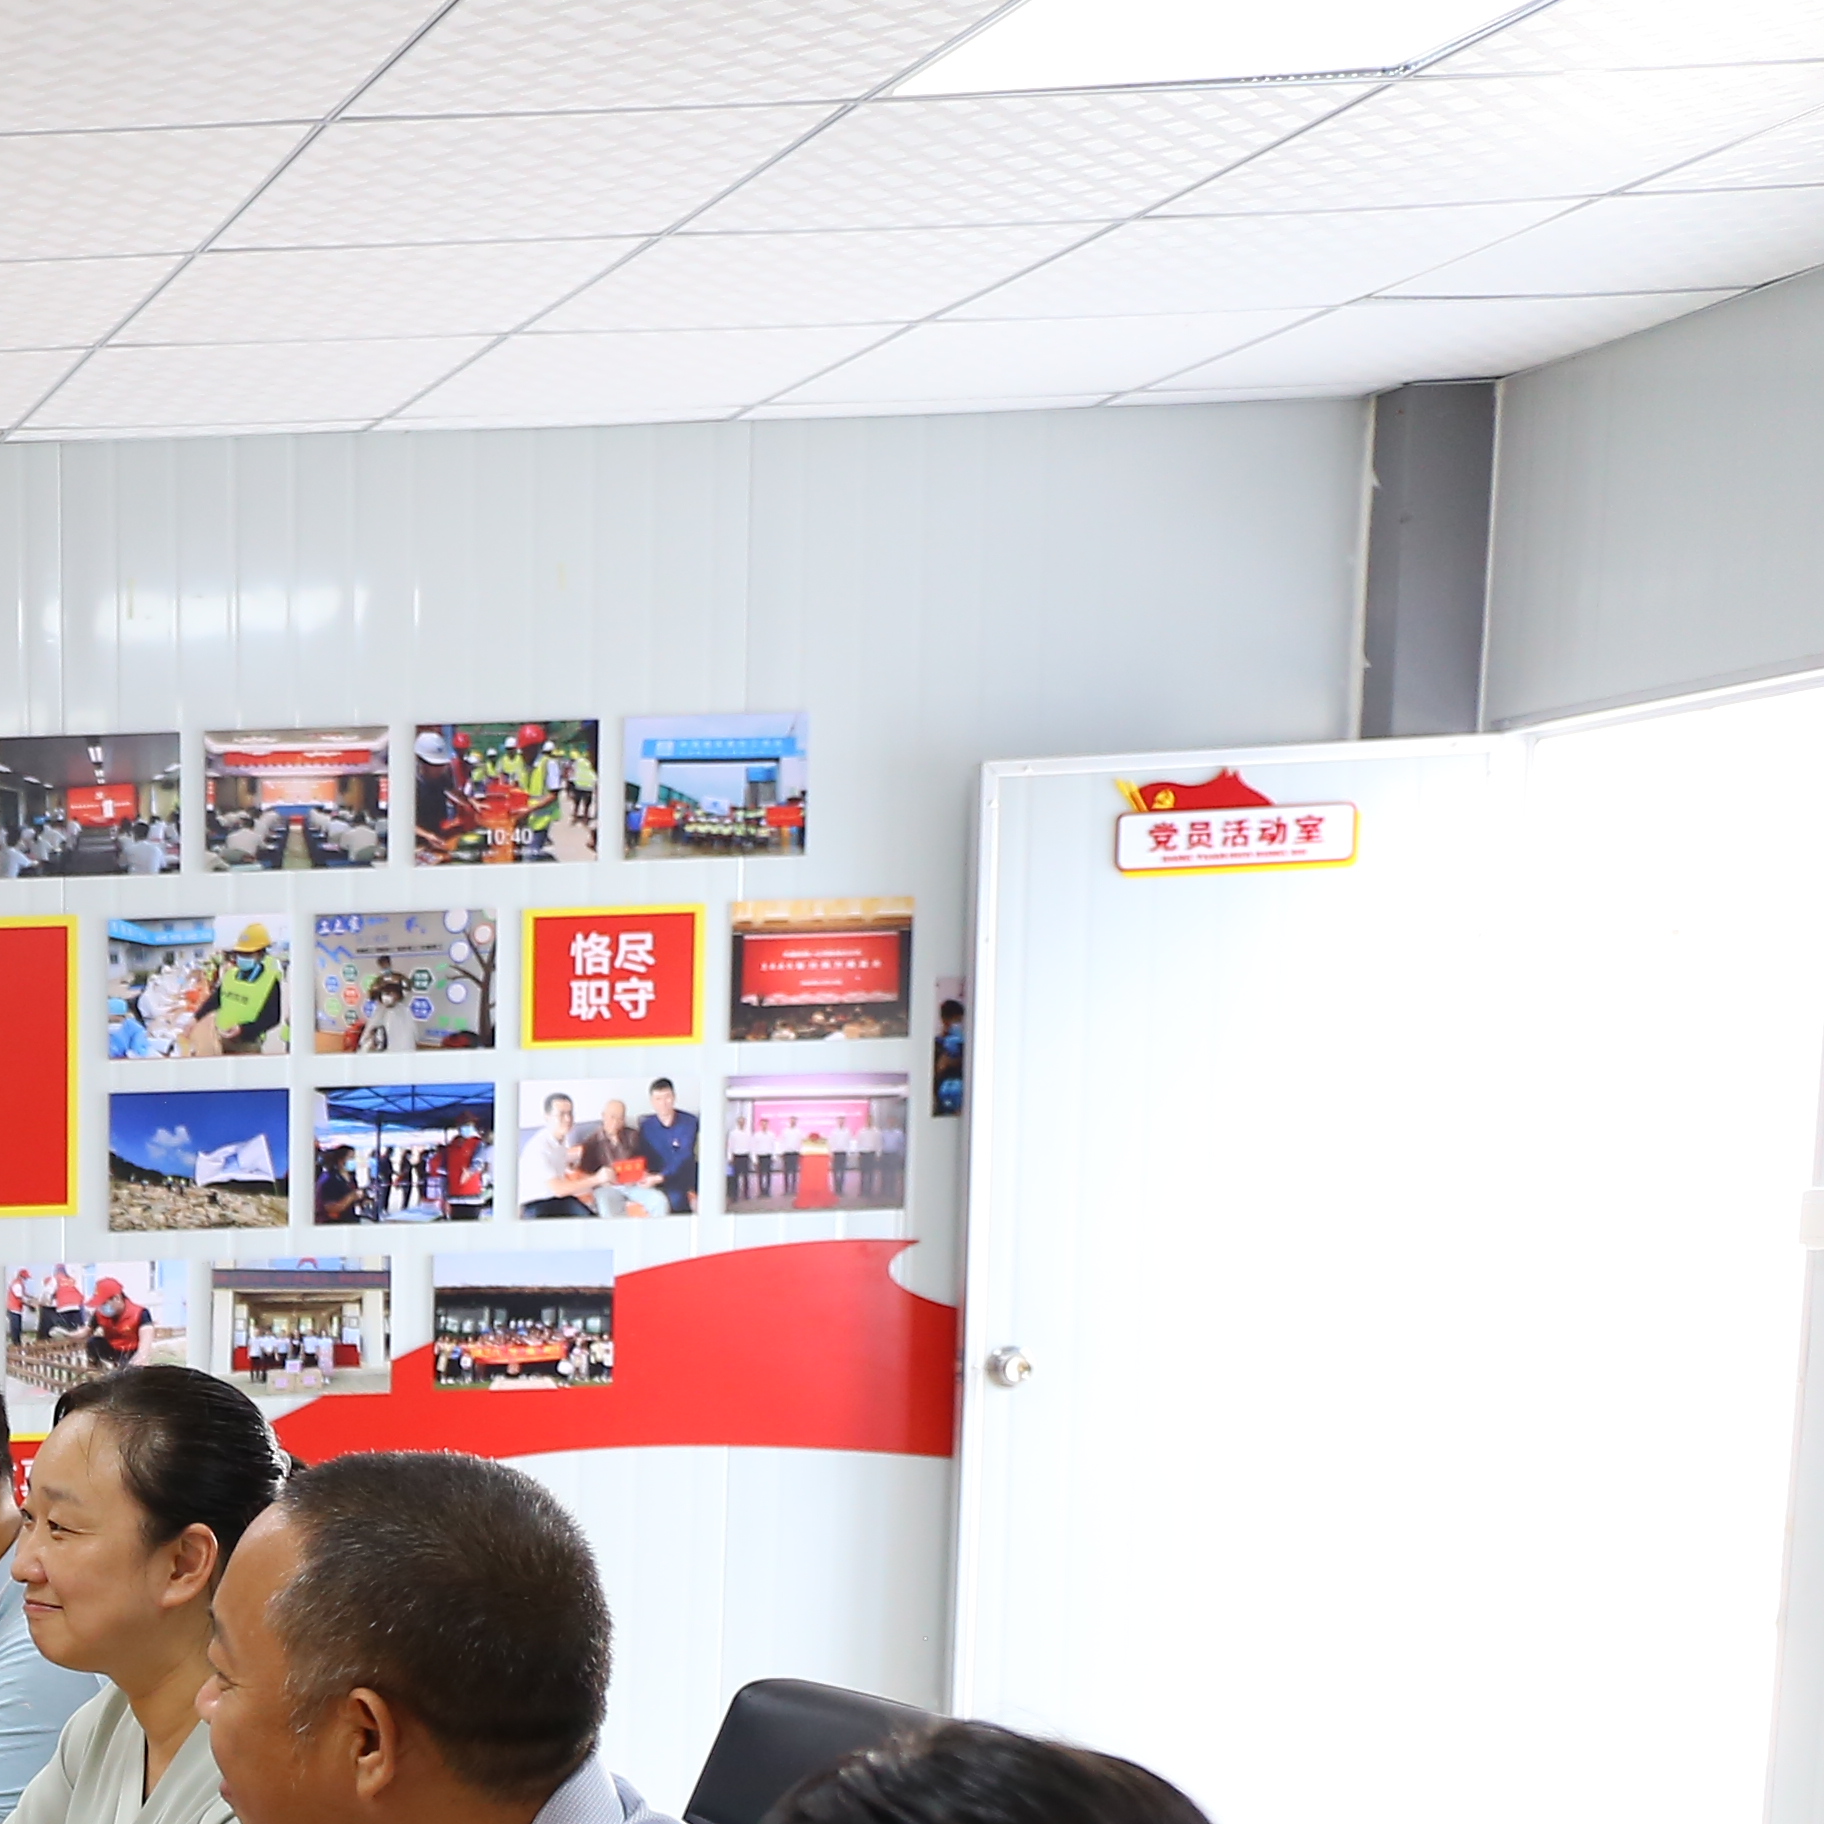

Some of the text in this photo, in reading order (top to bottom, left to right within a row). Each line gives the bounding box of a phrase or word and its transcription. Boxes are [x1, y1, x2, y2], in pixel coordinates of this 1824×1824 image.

[1149, 814, 1325, 852] 党员活动室
[569, 930, 656, 977] 恪尽
[568, 976, 656, 1023] 职守
